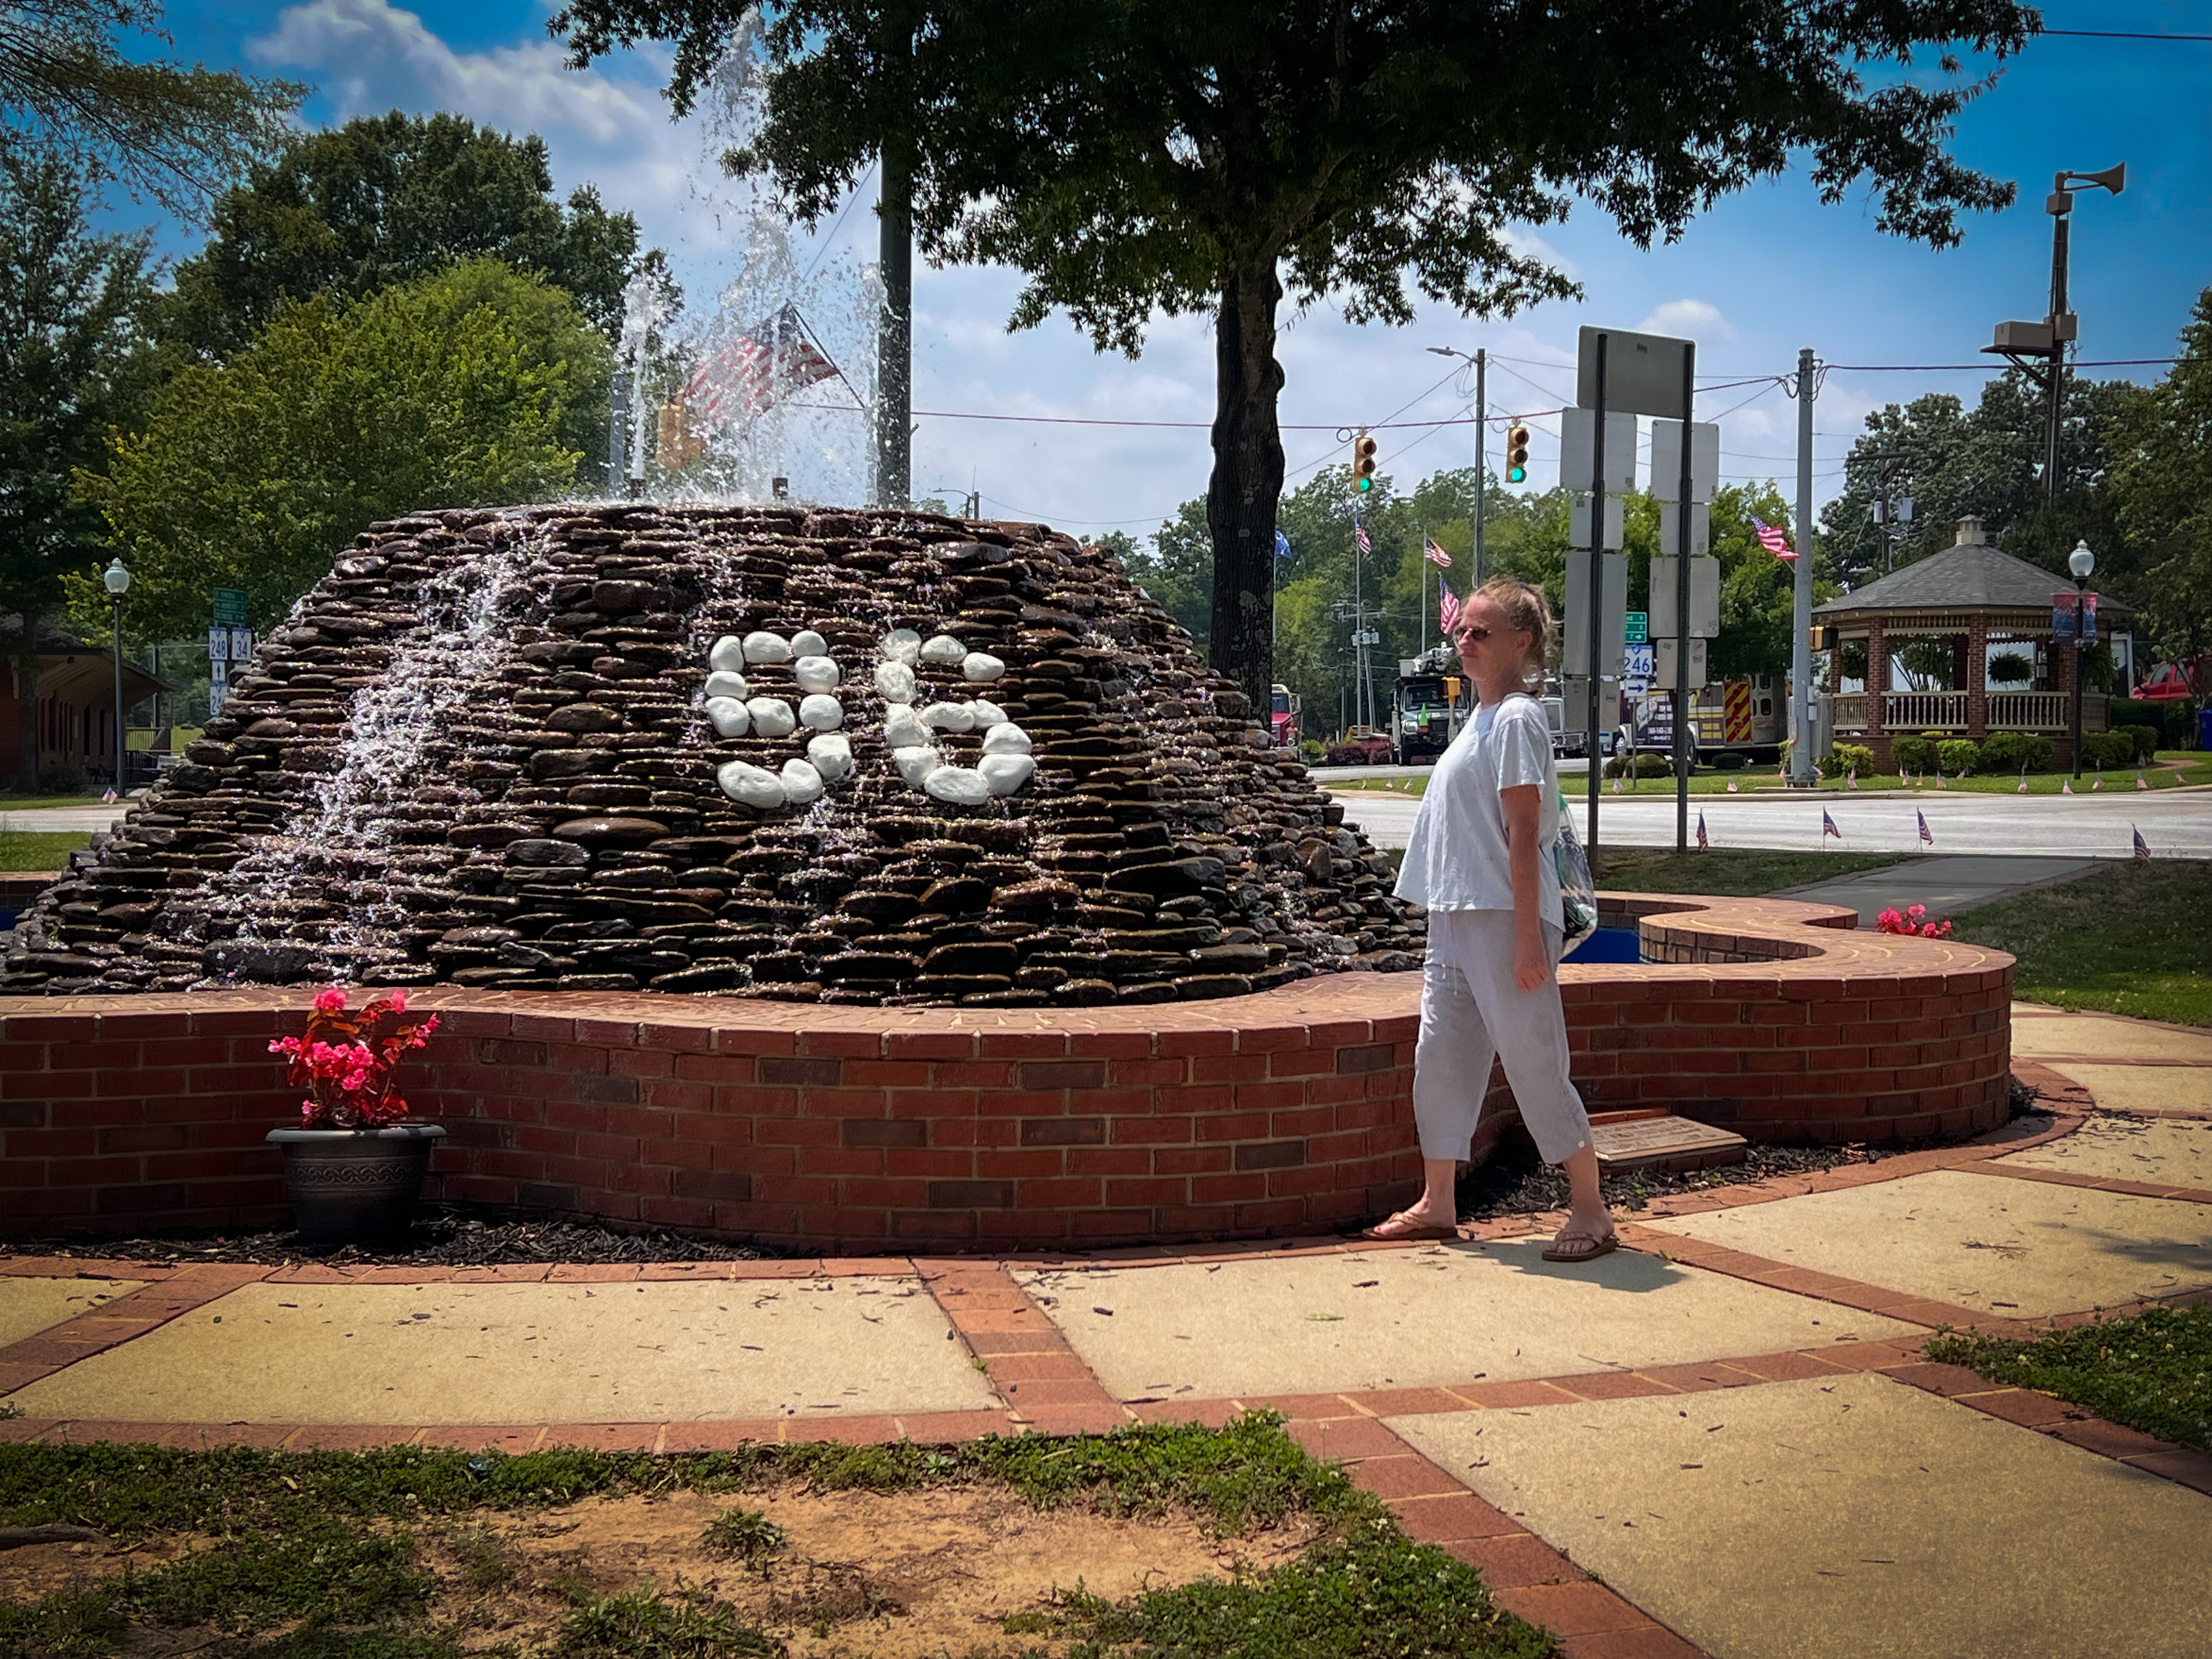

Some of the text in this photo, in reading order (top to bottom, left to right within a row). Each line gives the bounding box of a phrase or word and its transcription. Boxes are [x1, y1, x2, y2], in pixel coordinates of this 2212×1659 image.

[211, 640, 226, 658] 248
[236, 640, 248, 658] 34
[1624, 657, 1650, 673] 246
[704, 628, 1037, 809] 96
